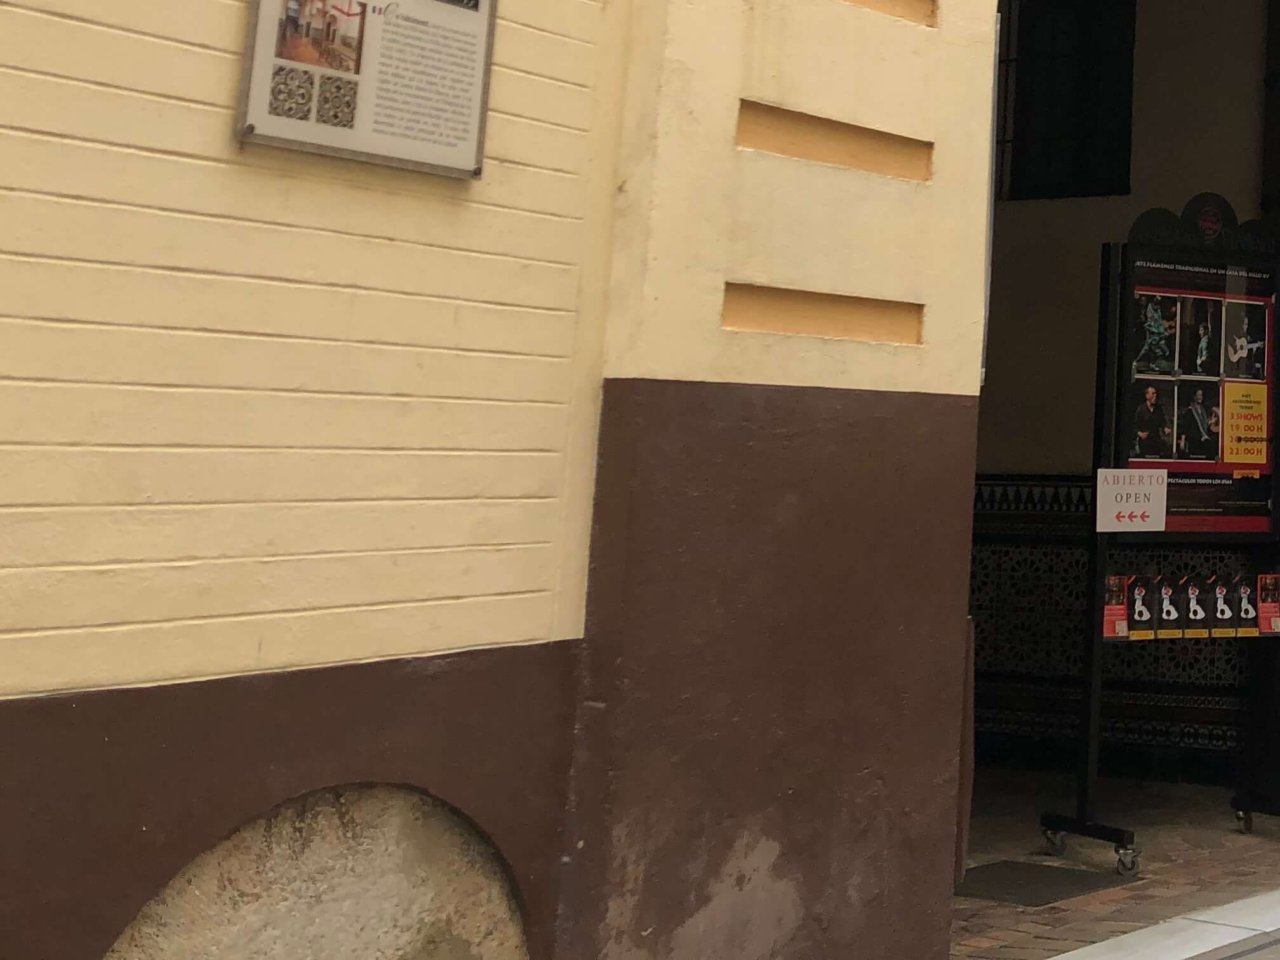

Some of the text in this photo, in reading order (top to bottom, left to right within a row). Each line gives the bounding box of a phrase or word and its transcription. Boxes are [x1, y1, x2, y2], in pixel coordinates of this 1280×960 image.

[1236, 412, 1263, 422] SHOWS
[1102, 474, 1165, 486] ABIERTO
[1115, 492, 1151, 504] OPEN
